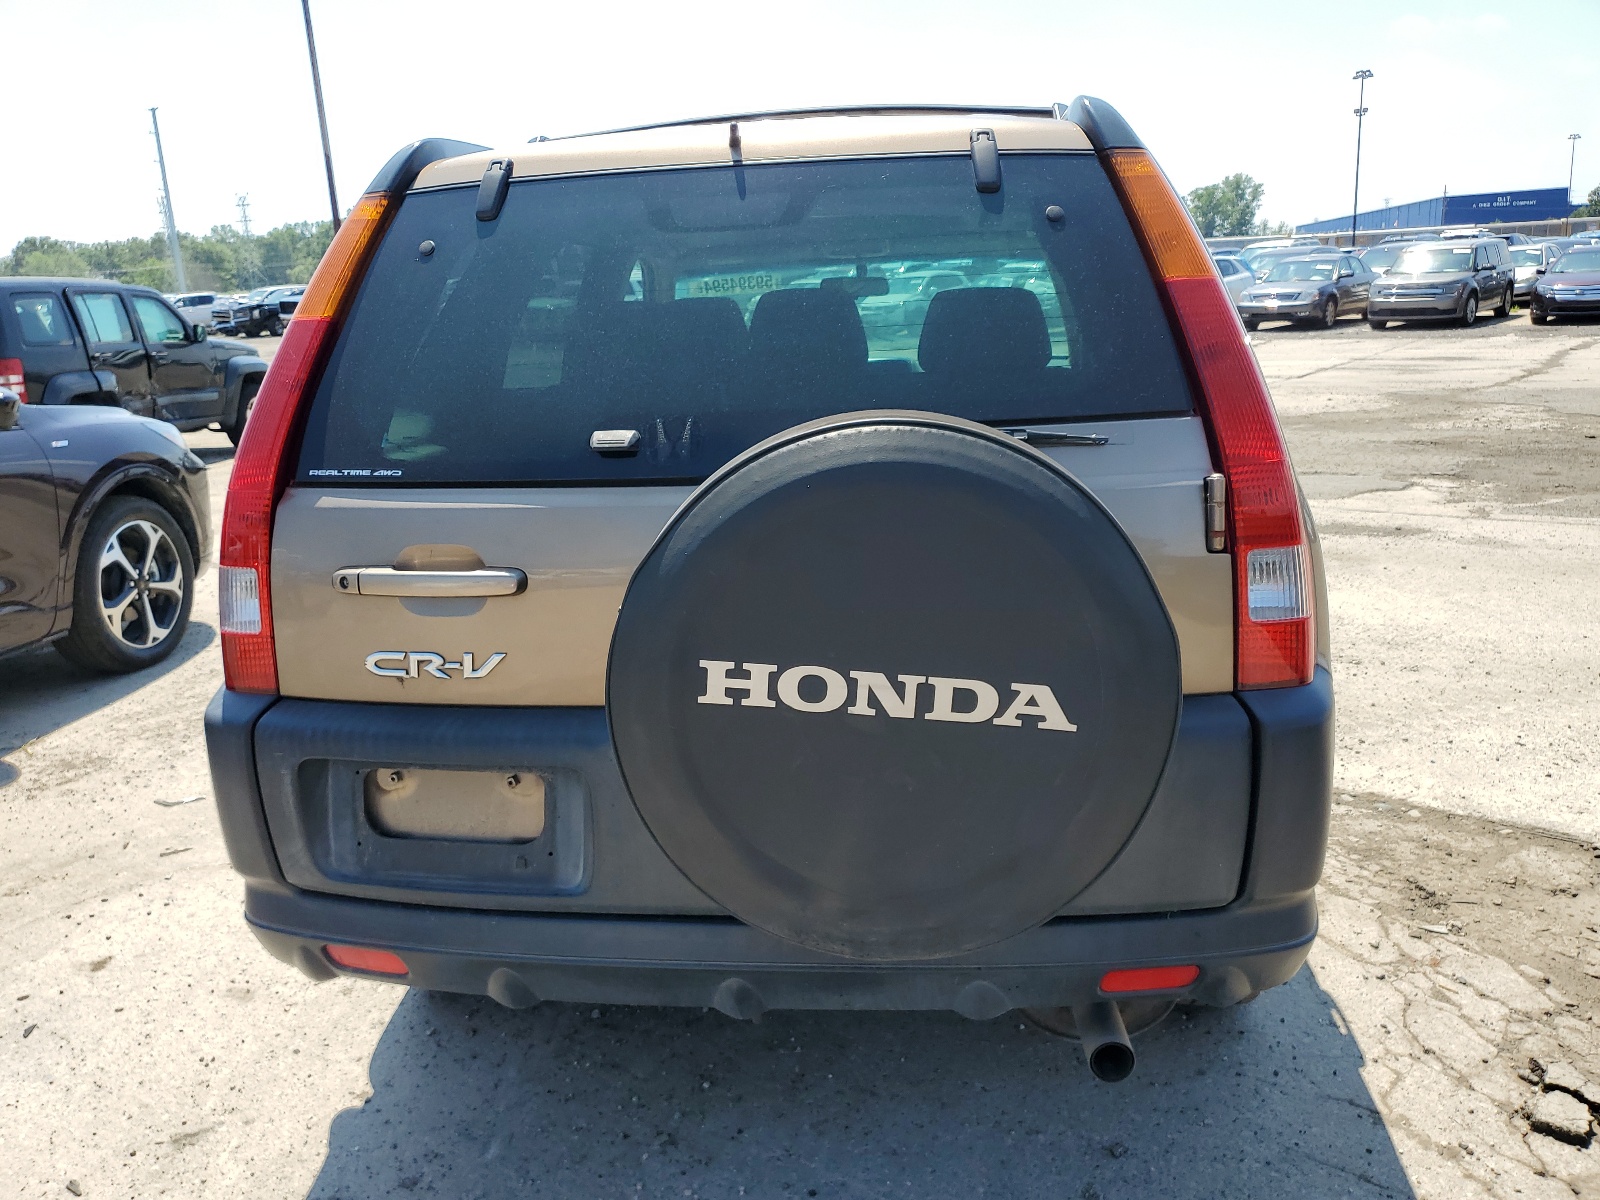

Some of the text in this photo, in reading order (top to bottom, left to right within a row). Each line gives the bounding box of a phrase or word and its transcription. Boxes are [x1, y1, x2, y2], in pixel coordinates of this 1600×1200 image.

[1512, 199, 1537, 207] COMPANY
[364, 651, 507, 679] CR-V
[697, 659, 1078, 732] HONDA
